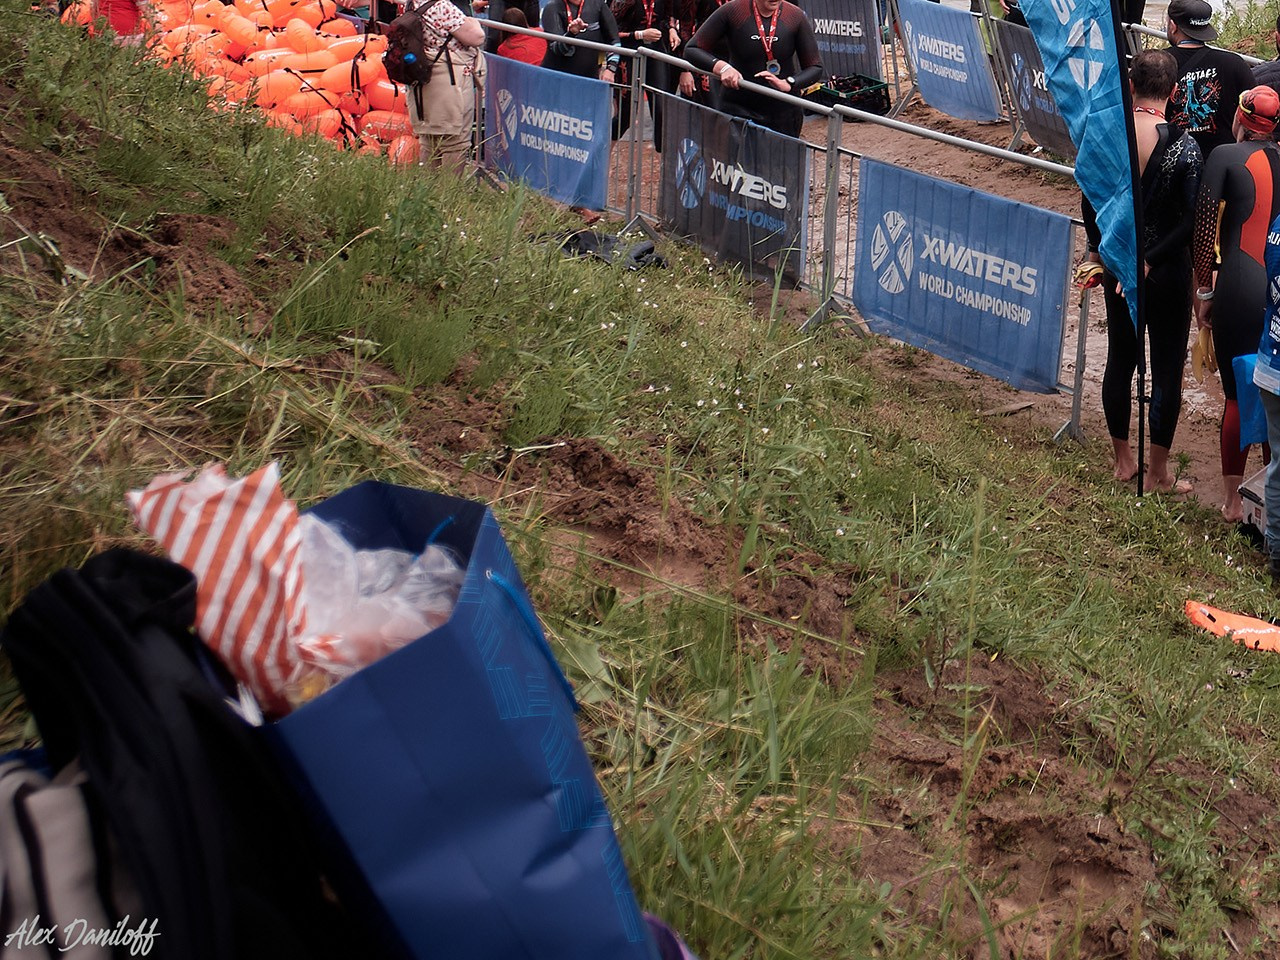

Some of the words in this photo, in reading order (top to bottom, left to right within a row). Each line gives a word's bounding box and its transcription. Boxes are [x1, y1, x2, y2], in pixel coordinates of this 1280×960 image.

[520, 131, 543, 151] WORLD
[919, 271, 954, 299] WORLD
[955, 285, 1032, 327] CHAMPIONSHIP
